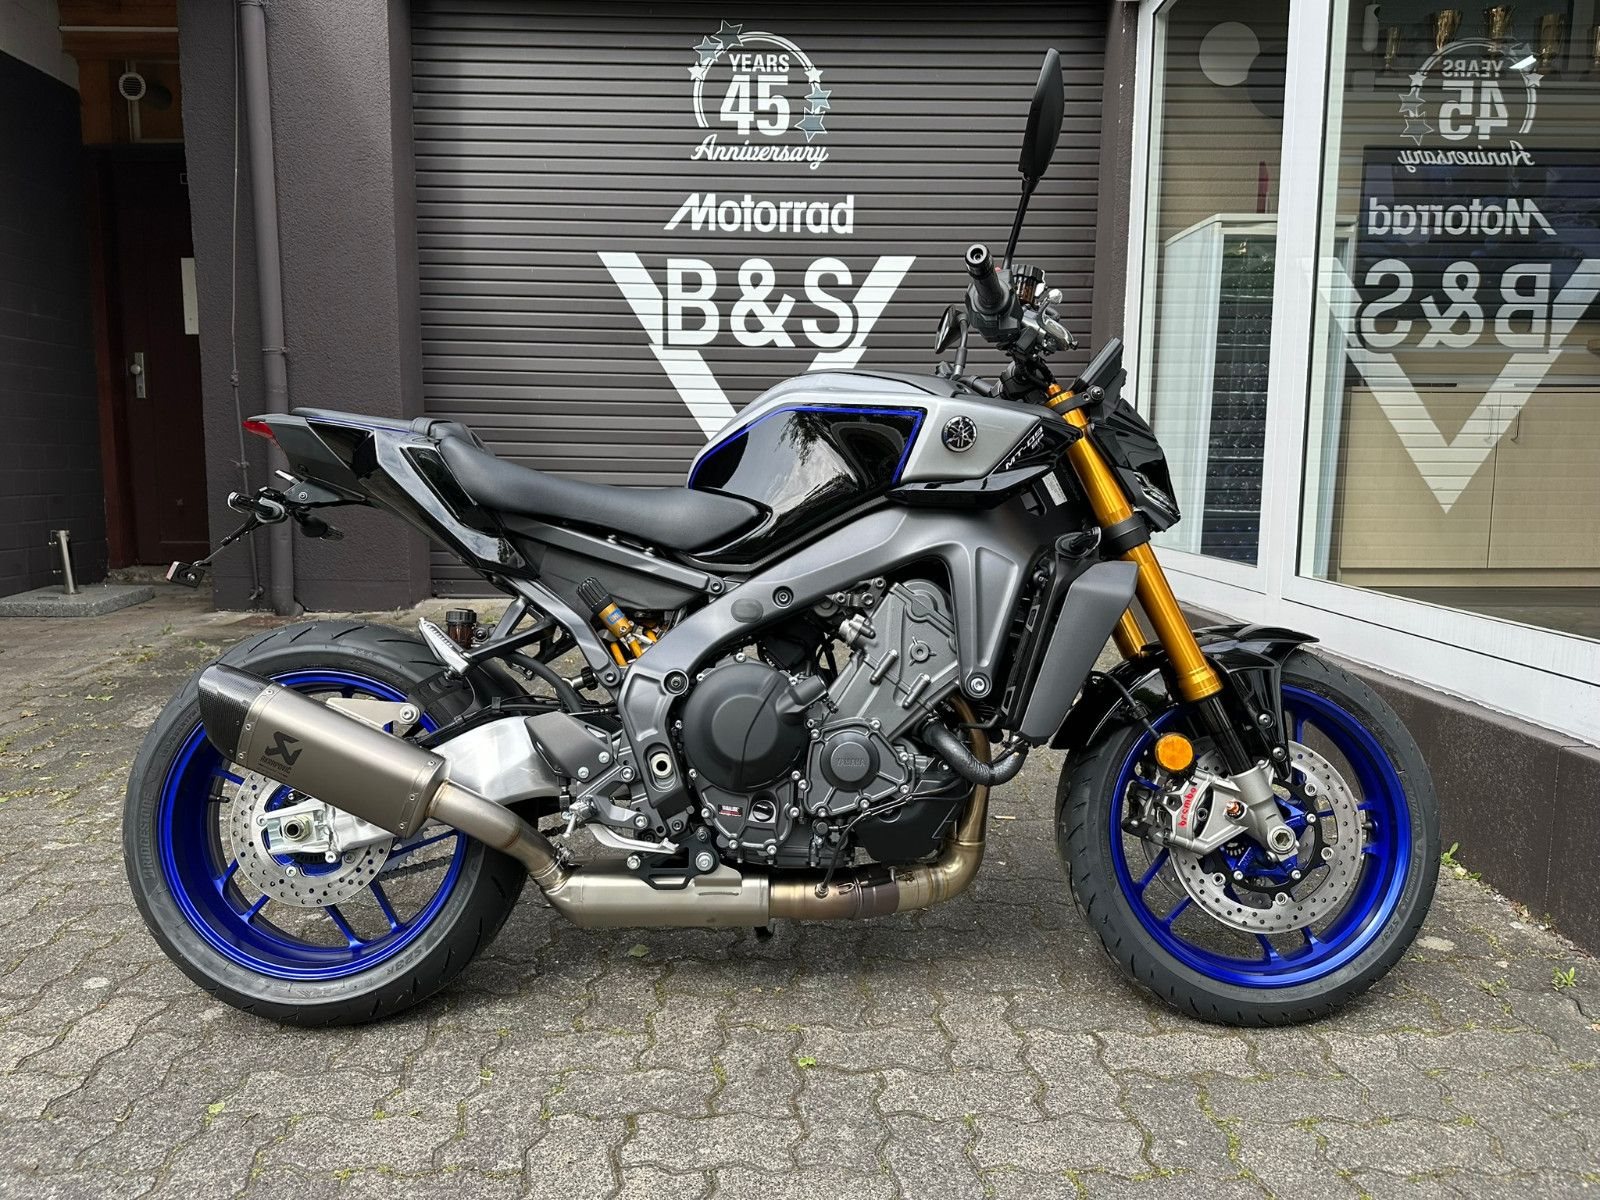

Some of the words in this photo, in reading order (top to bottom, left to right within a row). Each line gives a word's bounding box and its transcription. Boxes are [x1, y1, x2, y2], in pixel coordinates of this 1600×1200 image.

[728, 54, 790, 73] YEARS
[719, 74, 791, 136] 45
[690, 134, 829, 170] Anniversary
[663, 192, 854, 234] Motorrad
[666, 257, 854, 348] B&S
